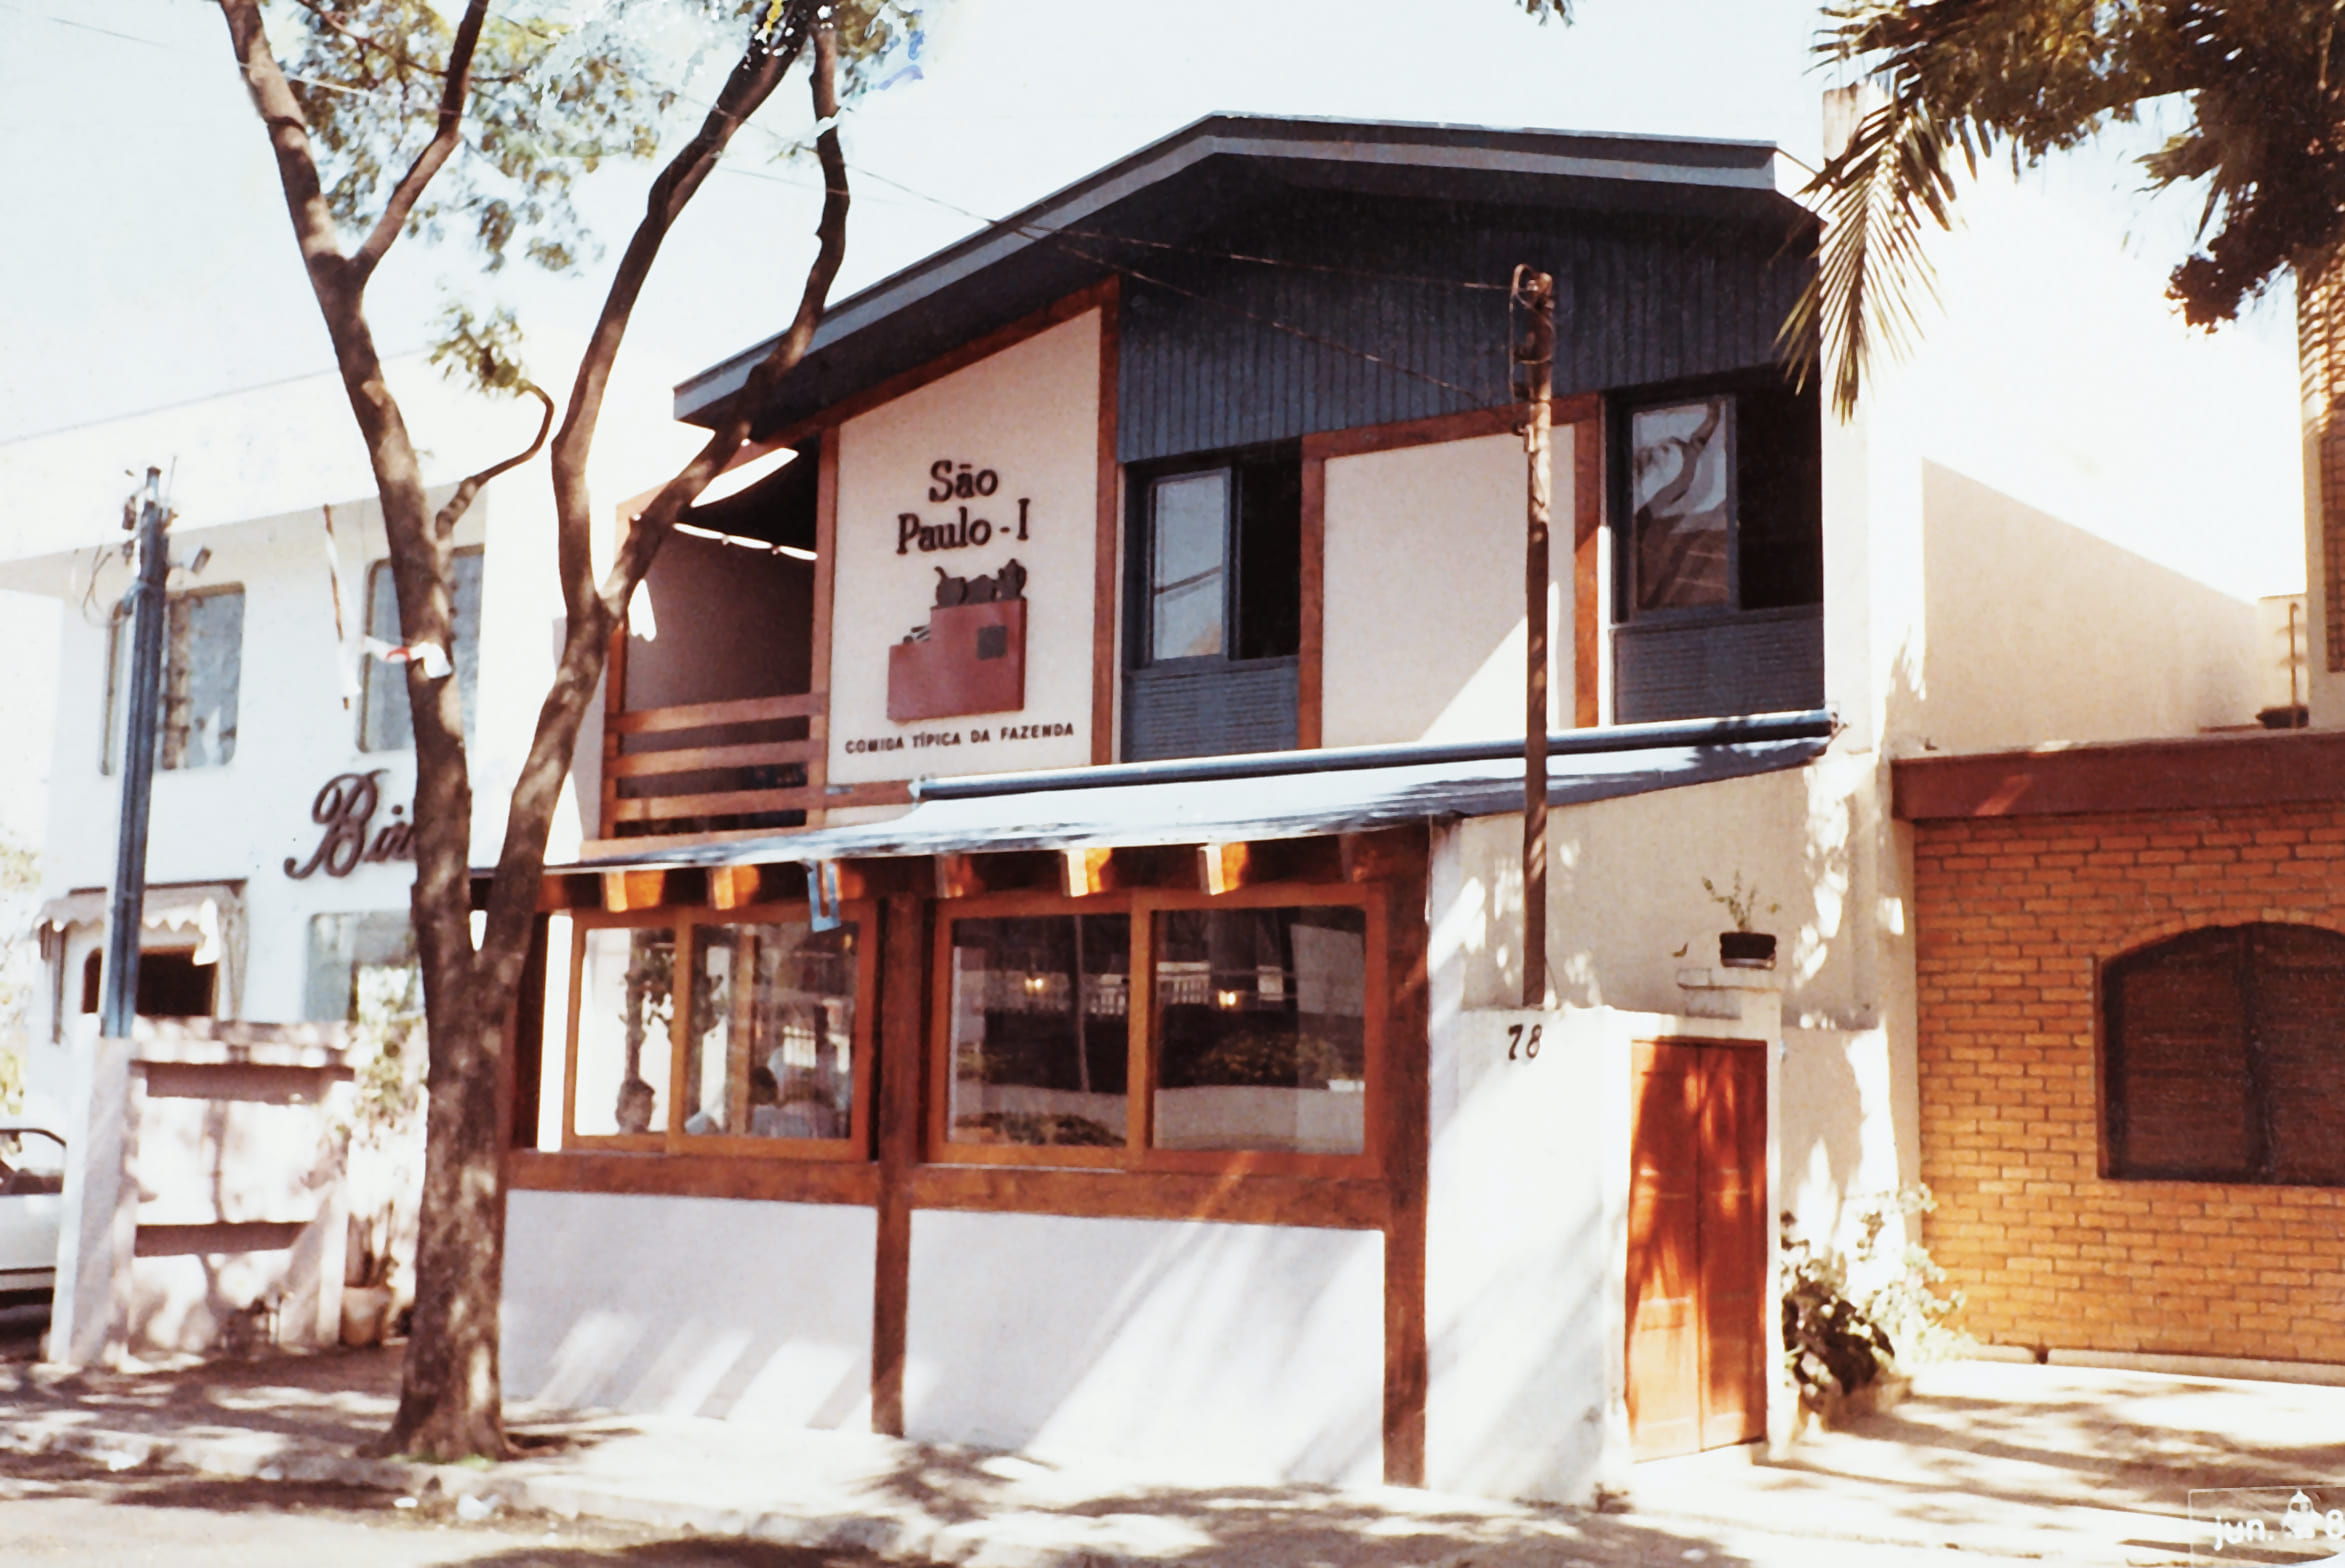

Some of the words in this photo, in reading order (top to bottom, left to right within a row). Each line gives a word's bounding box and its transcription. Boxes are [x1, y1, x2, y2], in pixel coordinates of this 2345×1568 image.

[928, 459, 999, 503] São
[845, 736, 904, 754] COMIDA
[912, 730, 962, 748] TÍPICA
[970, 728, 991, 743] DA
[1001, 722, 1074, 740] FAZENDA
[1508, 1024, 1543, 1060] 78
